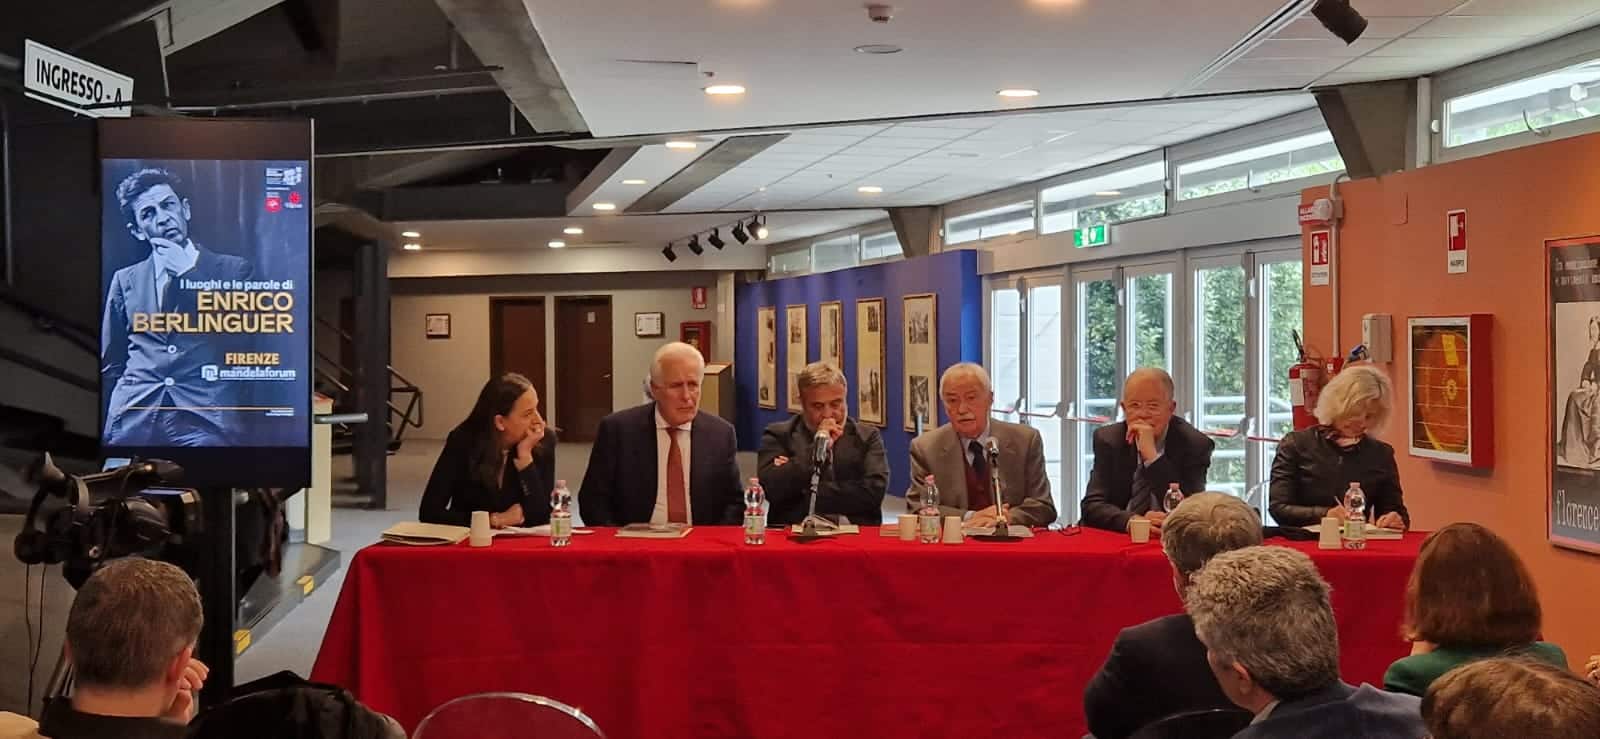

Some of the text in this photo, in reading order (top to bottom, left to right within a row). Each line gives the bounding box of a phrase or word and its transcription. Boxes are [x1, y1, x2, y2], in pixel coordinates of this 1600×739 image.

[36, 58, 103, 103] INGRESSO
[115, 87, 122, 110] A
[180, 279, 293, 292] I luoghi e le parole di
[197, 292, 294, 312] ENRICO
[132, 313, 295, 333] BERLINGUER
[225, 353, 280, 365] FIRENZE
[219, 366, 296, 378] mandelaforum
[1556, 489, 1599, 531] florence
